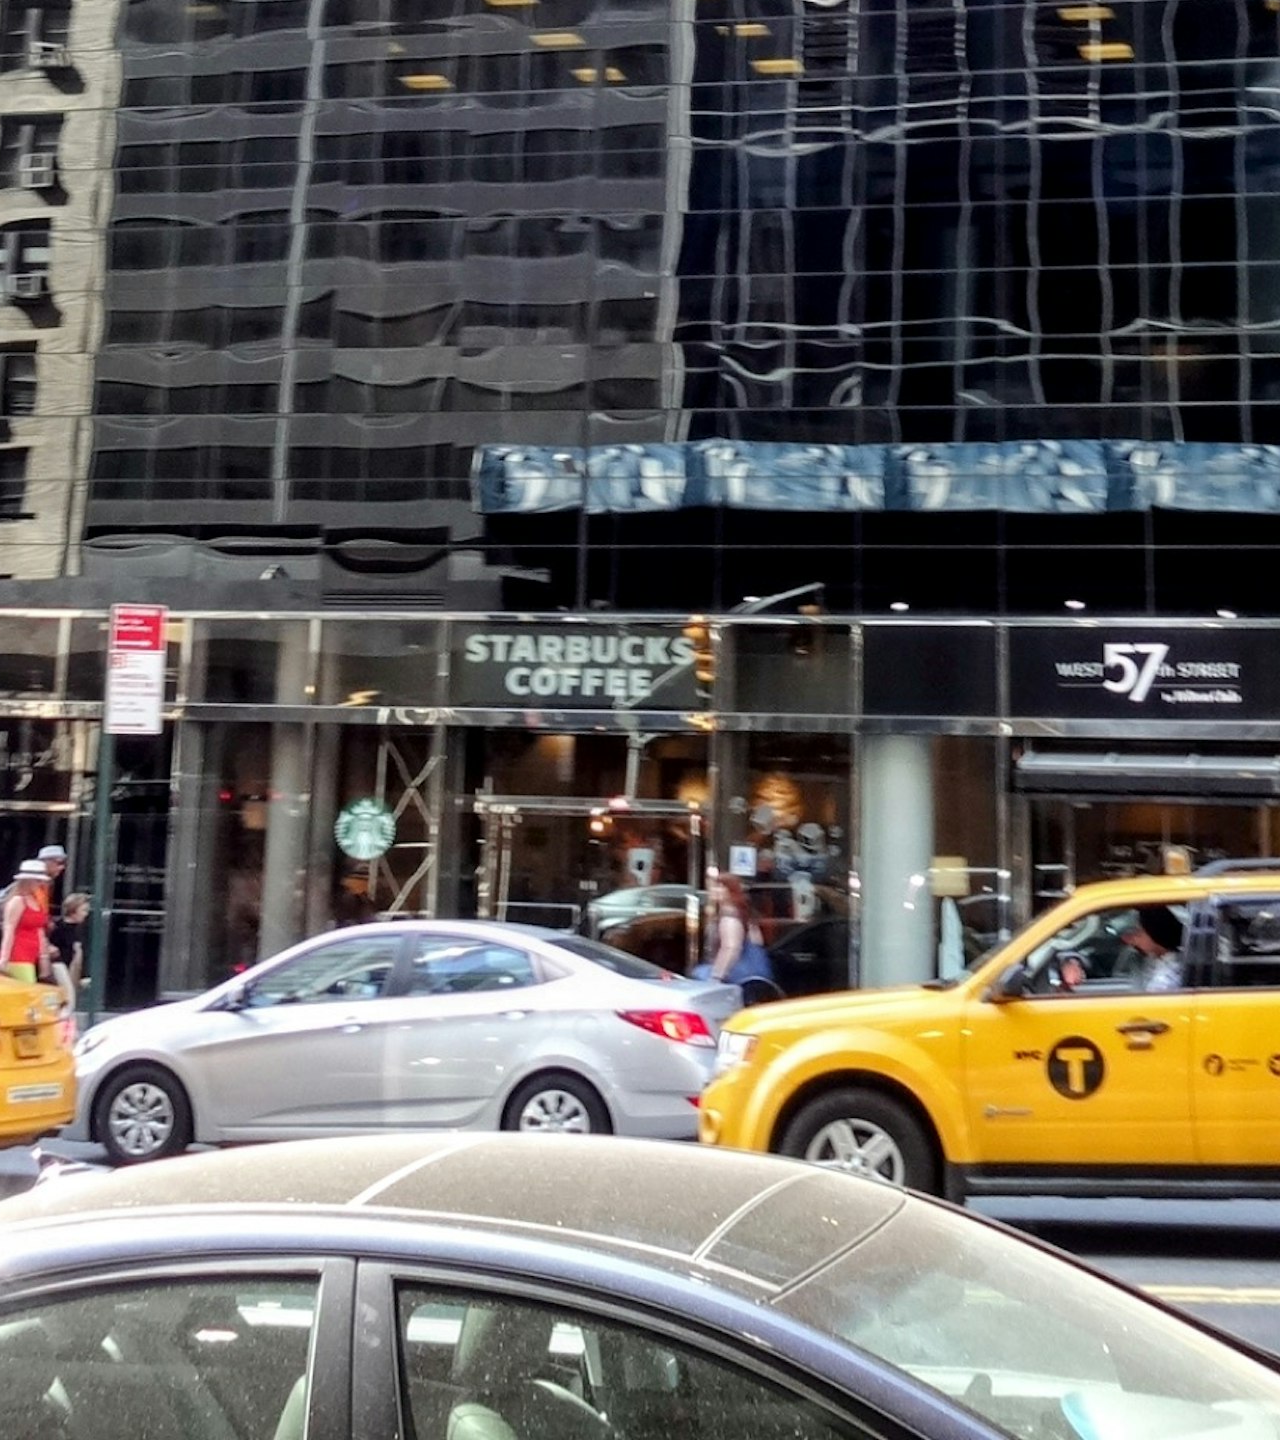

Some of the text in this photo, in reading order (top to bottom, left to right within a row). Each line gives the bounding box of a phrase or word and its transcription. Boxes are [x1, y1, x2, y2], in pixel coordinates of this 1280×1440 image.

[465, 634, 697, 665] STARBUCKS
[505, 667, 653, 696] COFFEE
[1055, 662, 1104, 677] WEST
[1177, 662, 1241, 677] STREET
[1054, 1045, 1097, 1094] T
